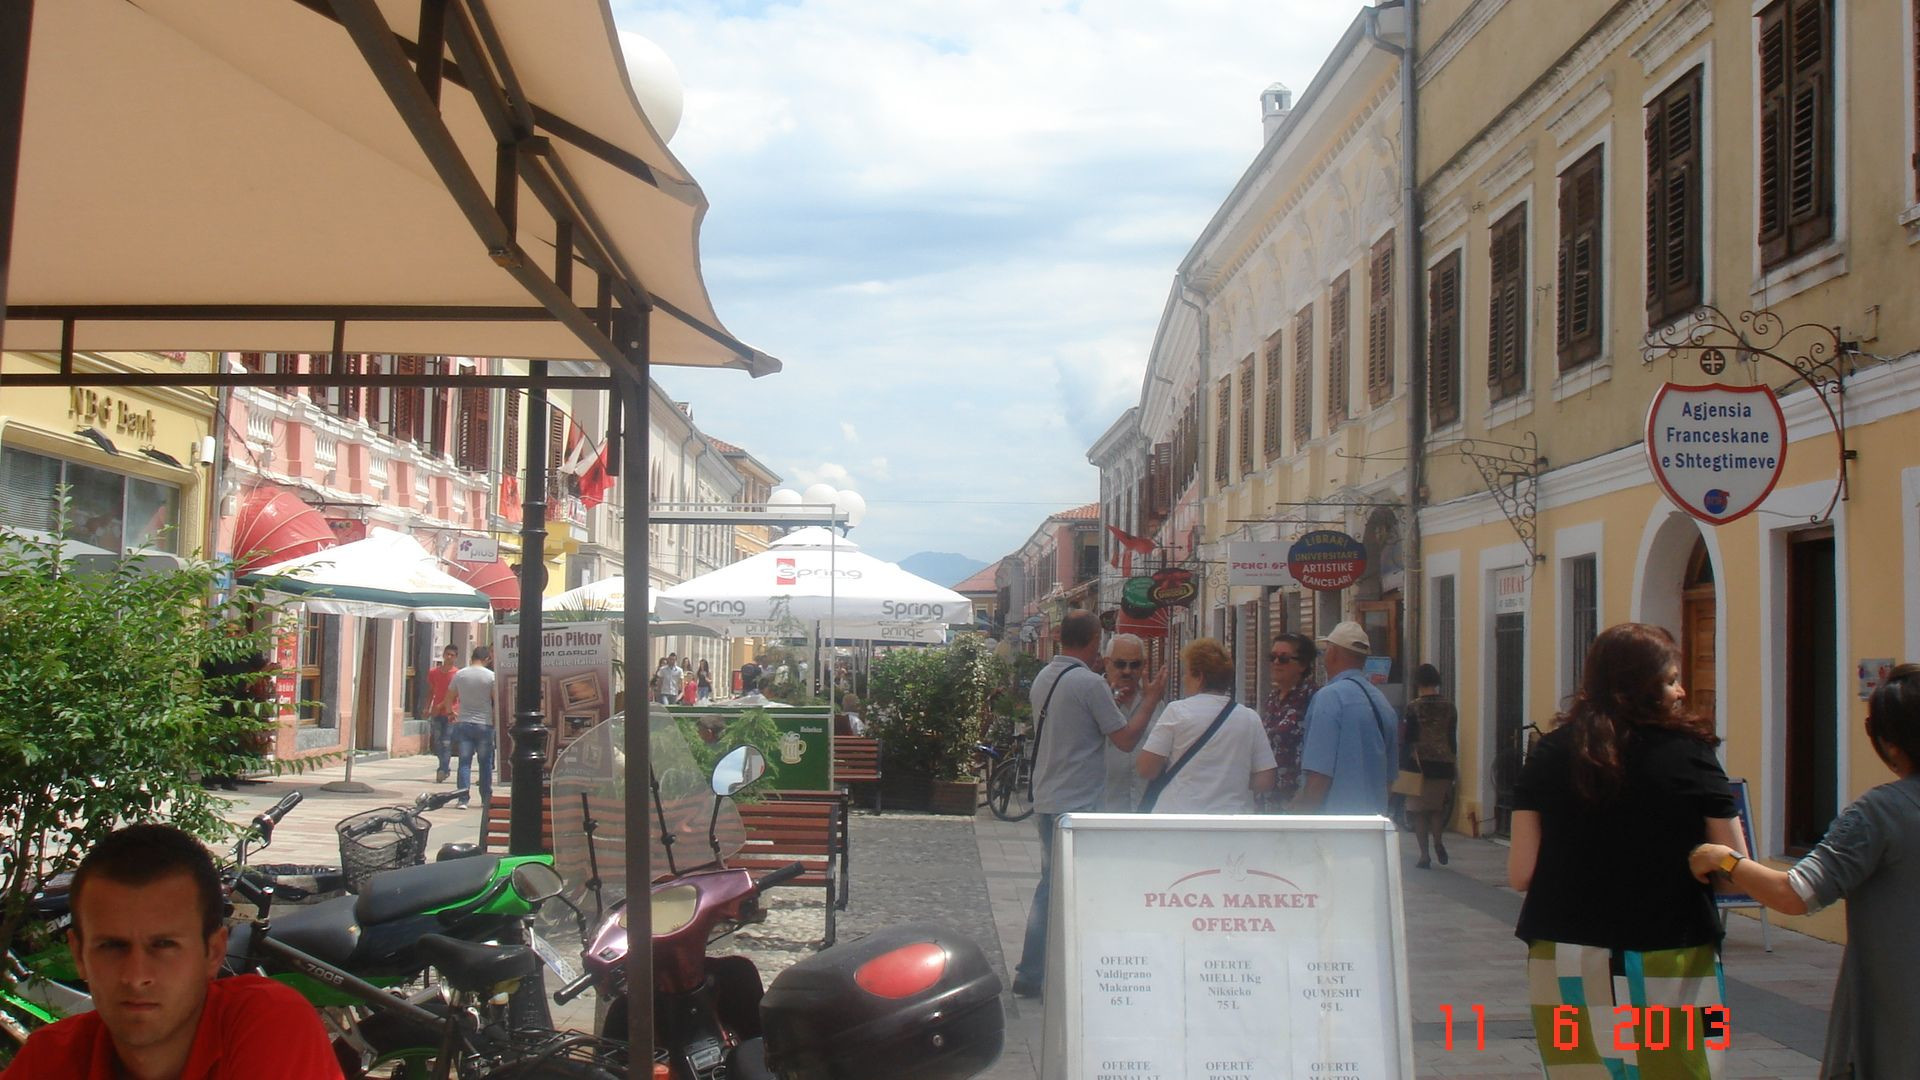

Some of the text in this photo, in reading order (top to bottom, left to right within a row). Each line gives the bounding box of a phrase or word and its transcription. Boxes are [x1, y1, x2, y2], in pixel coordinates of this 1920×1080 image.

[1682, 402, 1752, 421] Agjensia
[117, 400, 156, 439] Bank
[1666, 427, 1769, 443] Franceskane
[1662, 453, 1775, 472] e Shtegtimeve
[1302, 562, 1353, 574] ARTISTIKE
[780, 568, 863, 580] Spring
[1302, 574, 1352, 587] KANCELARI
[682, 599, 746, 618] Spring
[881, 600, 944, 620] Spring
[565, 631, 602, 646] Piktor
[1144, 893, 1319, 909] PIACA MARKET
[1191, 918, 1276, 932] OFERTA
[1100, 956, 1148, 966] OFERTE
[1204, 960, 1252, 970] OFERTE
[1307, 962, 1354, 972] OFERTE
[1096, 969, 1152, 980] Valdigrano
[1099, 982, 1152, 993] Makarona
[1302, 988, 1361, 999] QUMESHT
[1110, 997, 1122, 1006] 65
[1217, 1000, 1229, 1010] 75
[1320, 1002, 1332, 1012] 95
[1102, 1061, 1152, 1071] OFERTE
[1205, 1061, 1254, 1071] OFERTE
[1311, 1062, 1359, 1072] OFERTE
